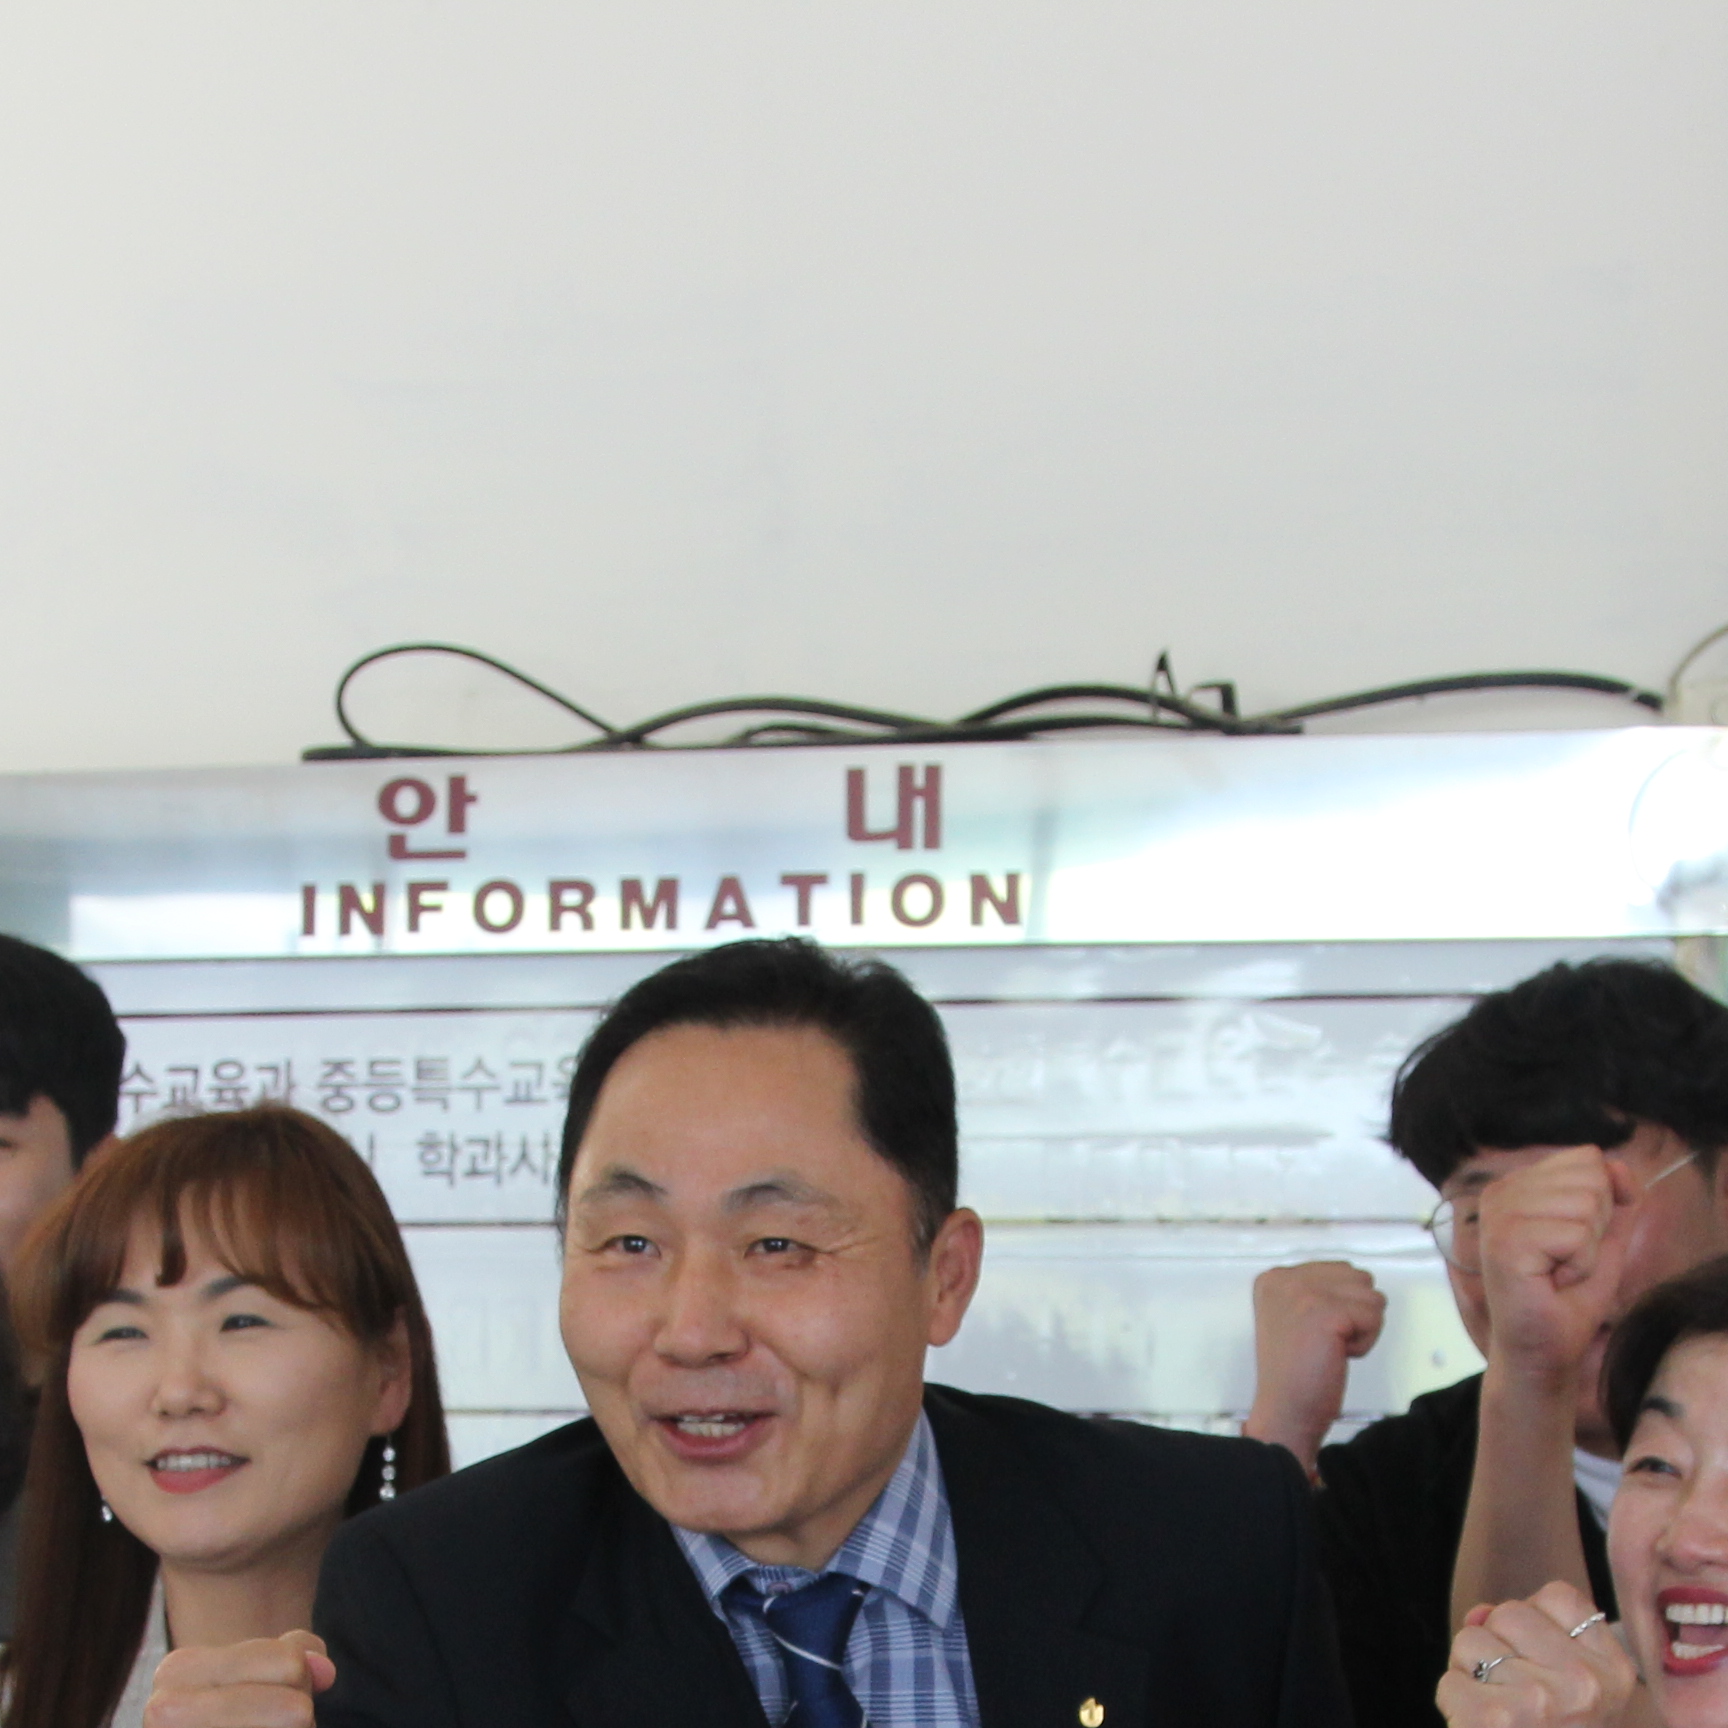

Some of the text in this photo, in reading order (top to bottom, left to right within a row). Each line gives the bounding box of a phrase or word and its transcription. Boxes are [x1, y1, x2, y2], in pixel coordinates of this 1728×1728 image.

[302, 871, 1024, 937] INFORMATION
[118, 1057, 296, 1114] 수교육과
[418, 1130, 558, 1187] 학과사
